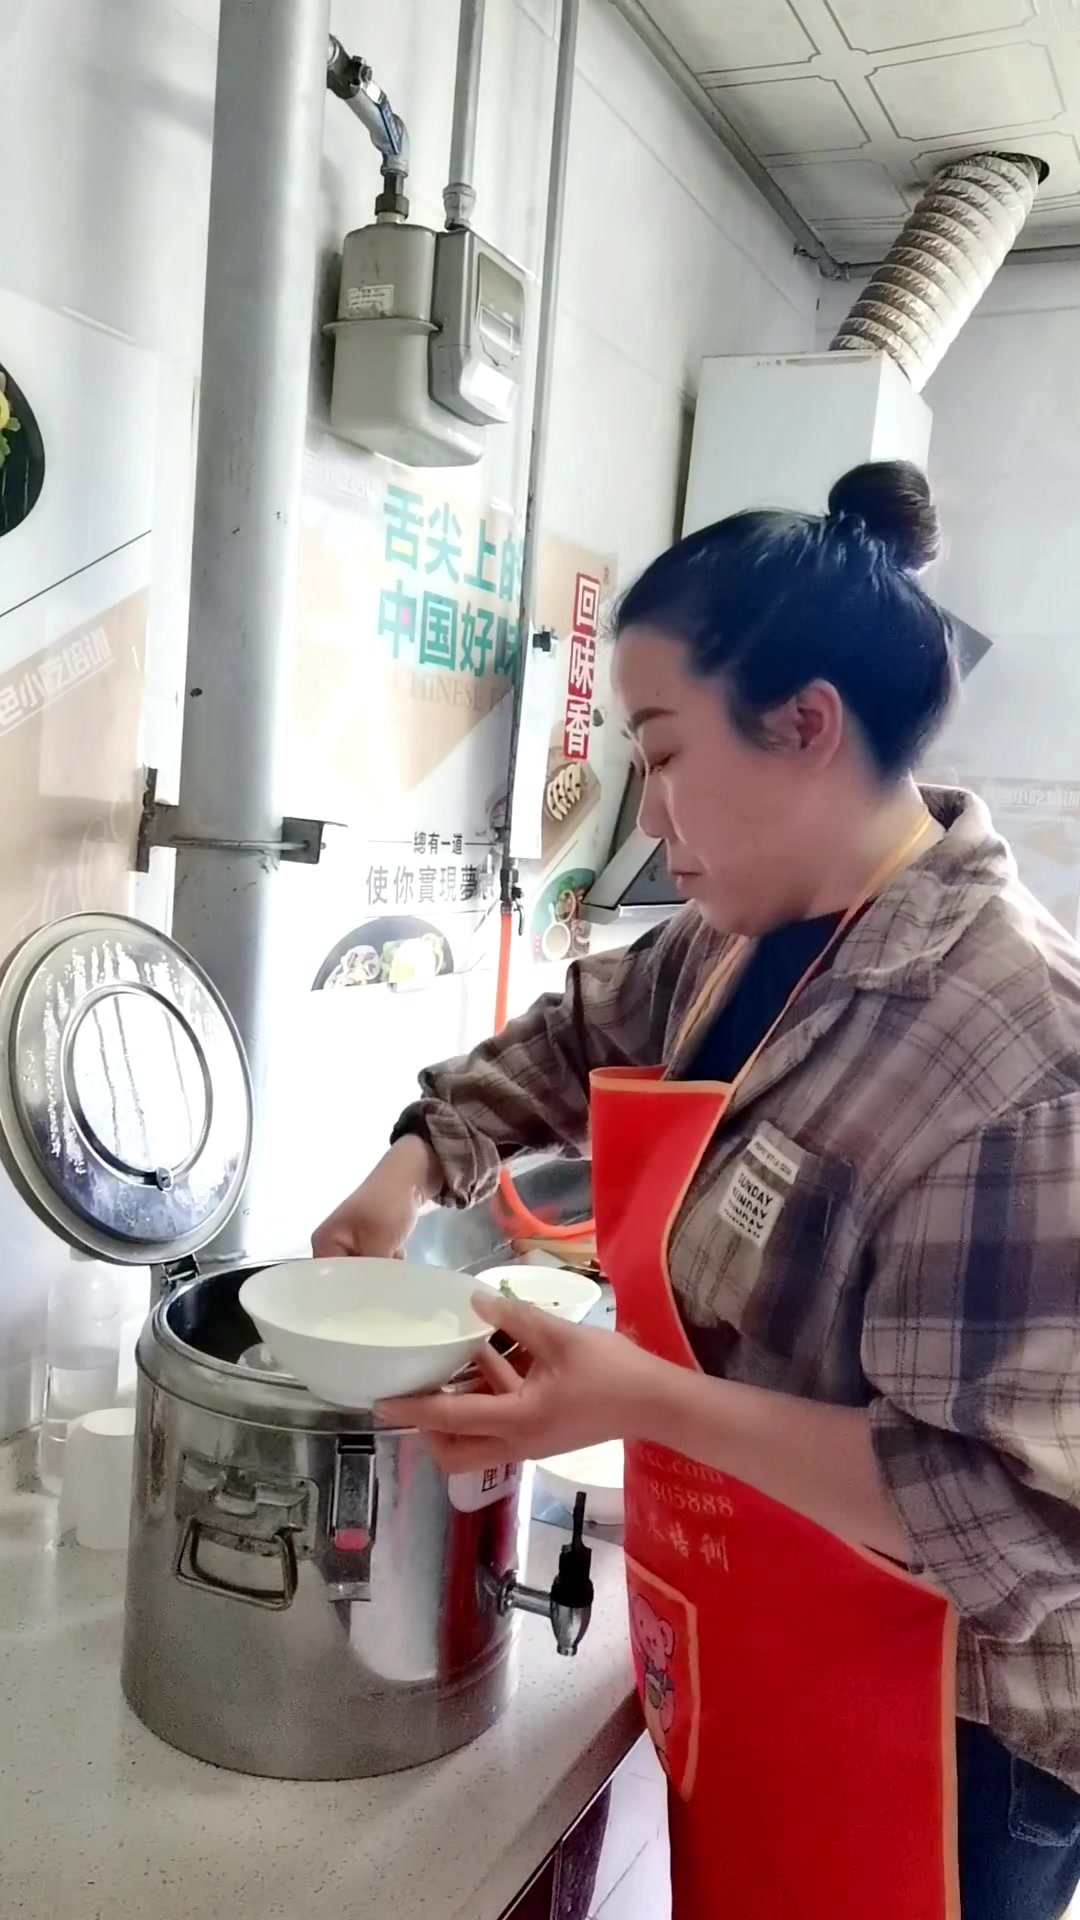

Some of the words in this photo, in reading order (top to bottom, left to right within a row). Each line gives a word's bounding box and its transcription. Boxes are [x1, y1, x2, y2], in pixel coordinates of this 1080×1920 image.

[566, 573, 600, 758] 回味香
[413, 831, 463, 856] 總有一道
